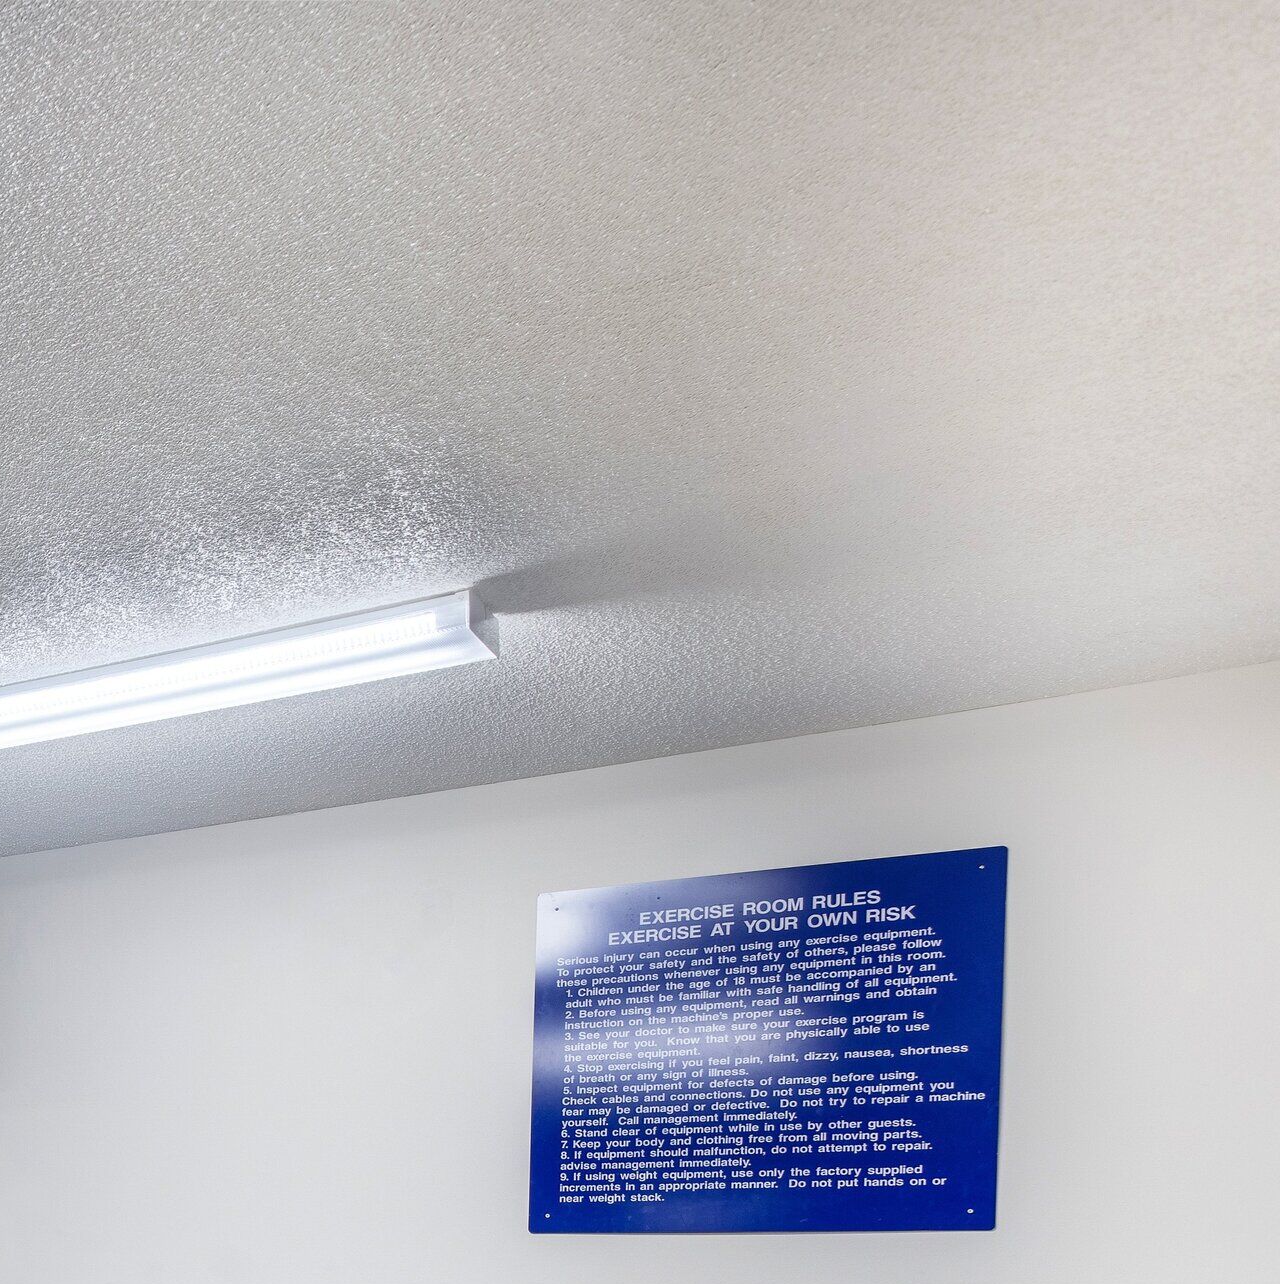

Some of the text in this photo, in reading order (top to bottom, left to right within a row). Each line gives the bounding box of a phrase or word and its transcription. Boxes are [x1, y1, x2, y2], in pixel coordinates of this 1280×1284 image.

[639, 889, 881, 925] EXERCISE ROOM RULES
[608, 904, 916, 945] EXERCISE AT YOUR OWN RISK
[556, 926, 936, 966] Serious injury can occur when using any exercise equipment.
[556, 938, 942, 978] To protect your safety and the safety of others, please follow
[556, 950, 946, 988] these precautions whenever using any equipment in this room.
[563, 1044, 969, 1074] 4. Stop exercising if you feel pain, faint, dizzy, nausea, shortness
[561, 1081, 954, 1106] Check cables and connections. Do not use any equipment you
[561, 1107, 584, 1116] fear
[588, 1107, 611, 1117] may
[616, 1105, 631, 1114] be
[635, 1102, 689, 1115] damaged
[710, 1100, 770, 1111] defective.
[779, 1099, 798, 1108] Do
[802, 1097, 823, 1107] not
[828, 1097, 847, 1108] try
[852, 1096, 866, 1105] to
[871, 1094, 910, 1106] repair
[928, 1092, 986, 1102] machine
[560, 1118, 916, 1138] 6. Stand clear of equipment while in use by other guests.
[560, 1129, 922, 1150] 7. Keep your body and clothing free from all moving parts.
[559, 1165, 923, 1183] 9. If using weight equipment, use only the factory supplied
[559, 1192, 665, 1204] near weight stack.
